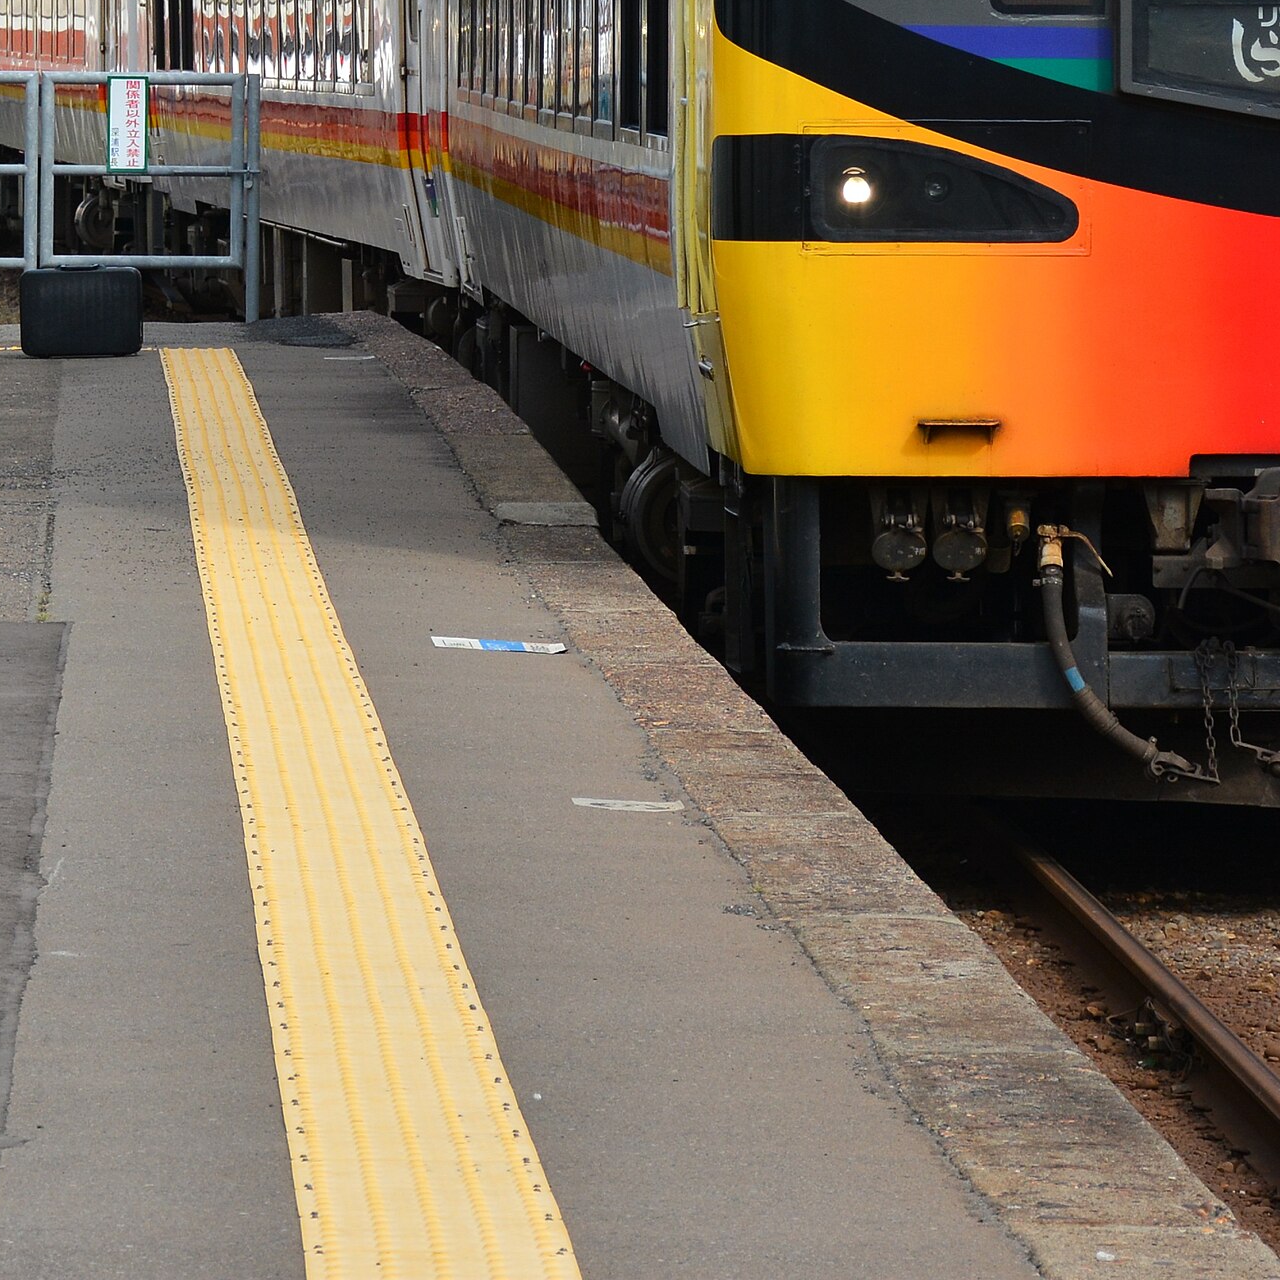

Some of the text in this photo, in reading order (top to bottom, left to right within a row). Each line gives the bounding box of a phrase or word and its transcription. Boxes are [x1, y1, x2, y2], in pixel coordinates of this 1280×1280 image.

[125, 80, 141, 167] 関係者以外立入禁止
